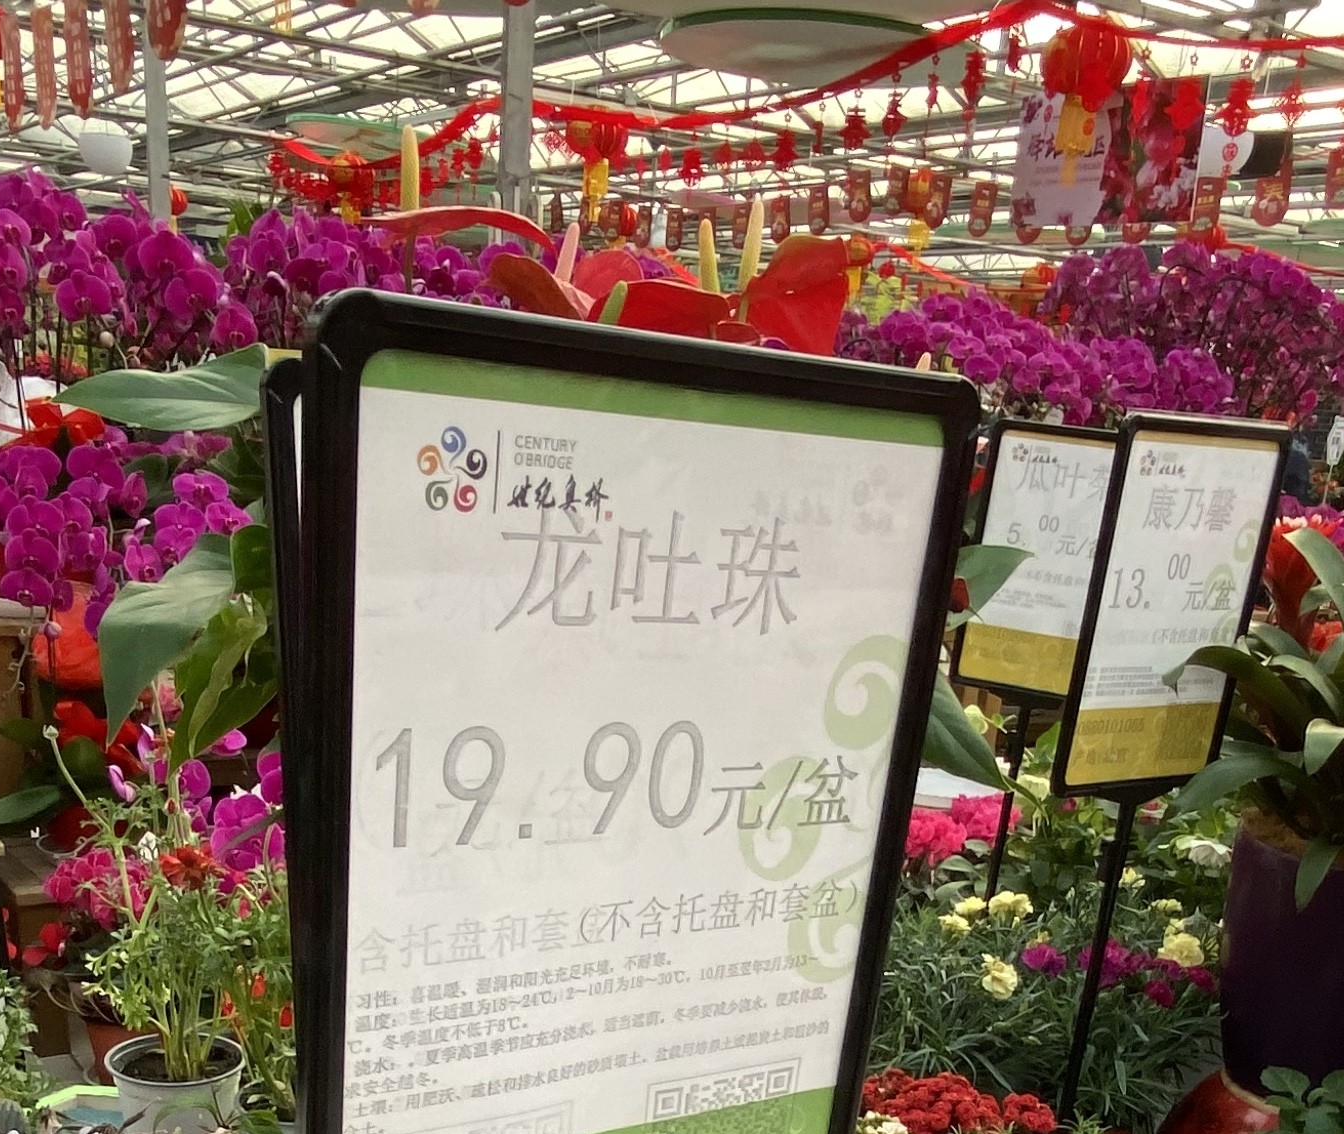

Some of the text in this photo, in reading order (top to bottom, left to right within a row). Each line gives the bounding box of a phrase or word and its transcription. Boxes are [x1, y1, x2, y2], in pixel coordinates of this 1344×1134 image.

[514, 434, 578, 452] CENTURY
[514, 452, 574, 470] O'BRIDGE
[1142, 485, 1237, 532] 康乃馨
[494, 508, 801, 636] 龙吐珠
[1108, 553, 1236, 612] 13. 00 元/盆
